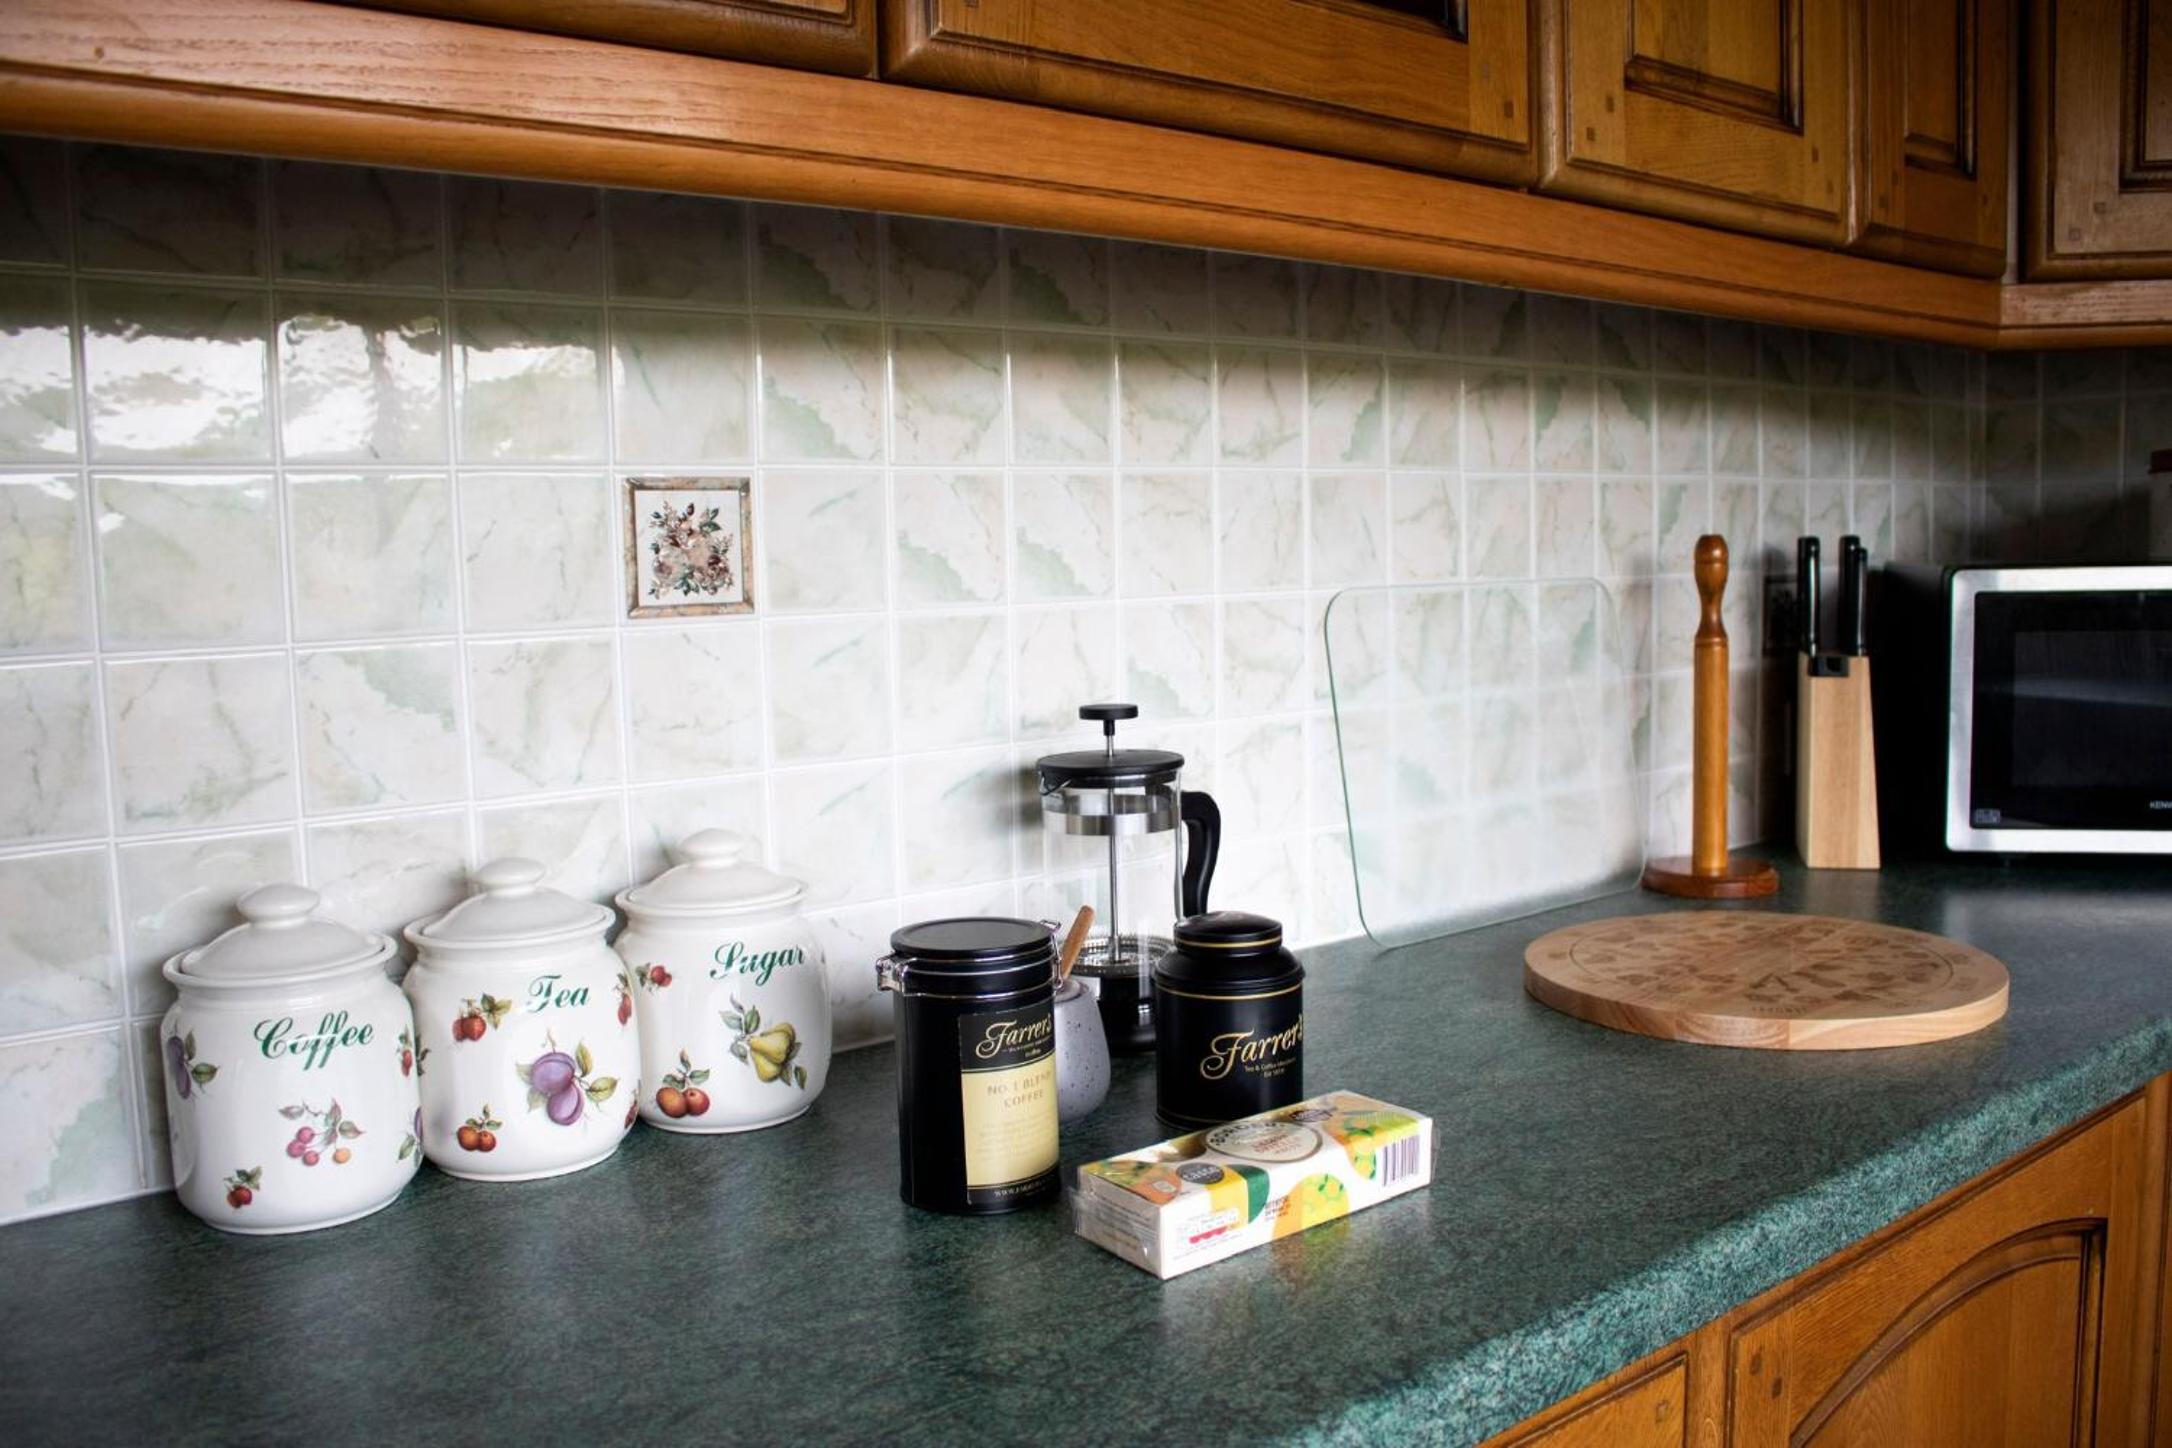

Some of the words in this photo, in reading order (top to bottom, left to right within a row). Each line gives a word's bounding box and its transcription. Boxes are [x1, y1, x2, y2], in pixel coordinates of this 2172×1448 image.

[709, 941, 805, 987] Sugar
[525, 974, 590, 1014] Tea
[253, 1010, 374, 1071] Coffee
